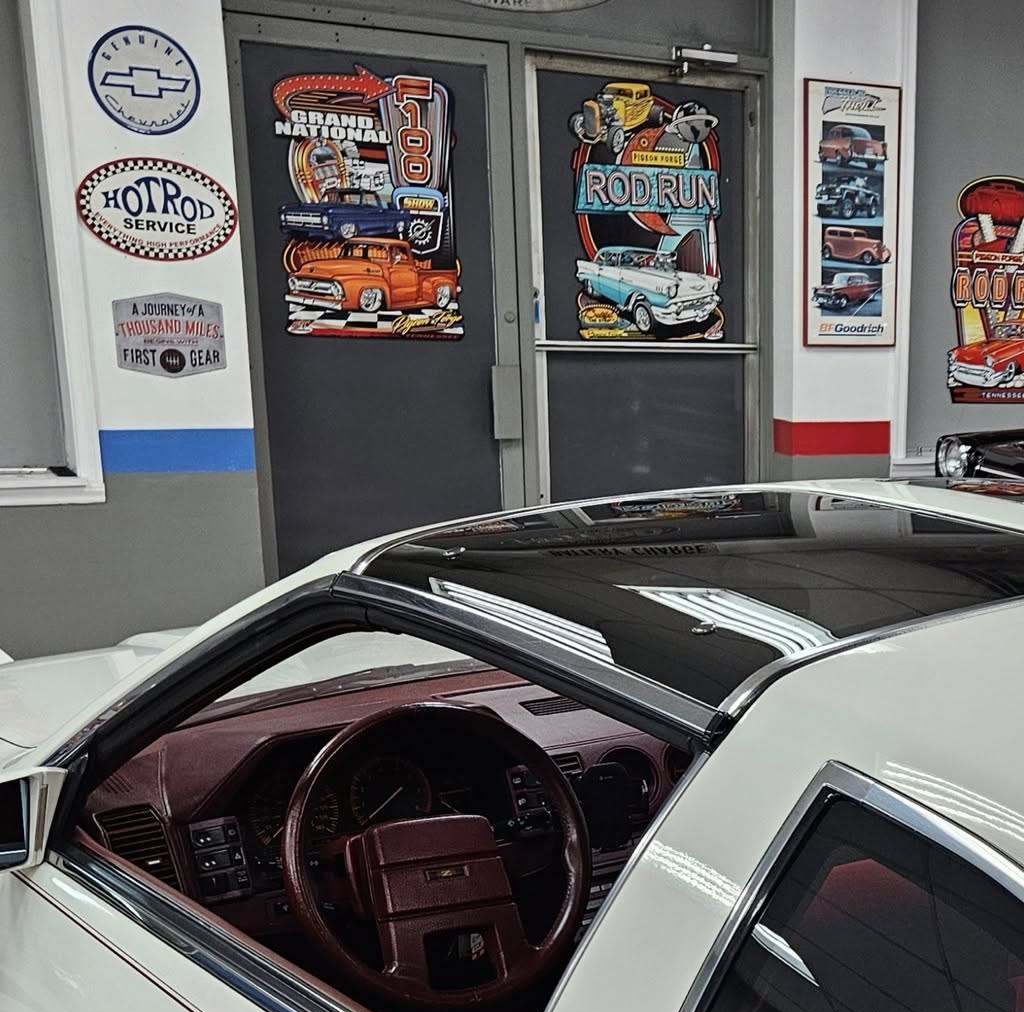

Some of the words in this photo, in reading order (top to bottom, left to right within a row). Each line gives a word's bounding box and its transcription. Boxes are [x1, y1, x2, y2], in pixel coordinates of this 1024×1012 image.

[104, 94, 190, 127] Chevrolet
[291, 110, 374, 129] GRAND
[275, 121, 392, 144] NATIONAL
[585, 170, 653, 207] ROD
[657, 173, 718, 211] RUN
[403, 197, 436, 209] SHOW
[93, 211, 144, 246] EVERYTHING
[168, 223, 222, 248] PERFORMANCE
[123, 218, 197, 235] SERVICE
[955, 271, 1009, 304] ROD
[132, 303, 139, 316] A
[141, 303, 186, 316] JOURNEY
[198, 304, 205, 317] A
[119, 319, 182, 337] THOUSAND
[185, 321, 220, 339] MILES
[123, 348, 157, 367] FIRST
[190, 349, 220, 368] GEAR
